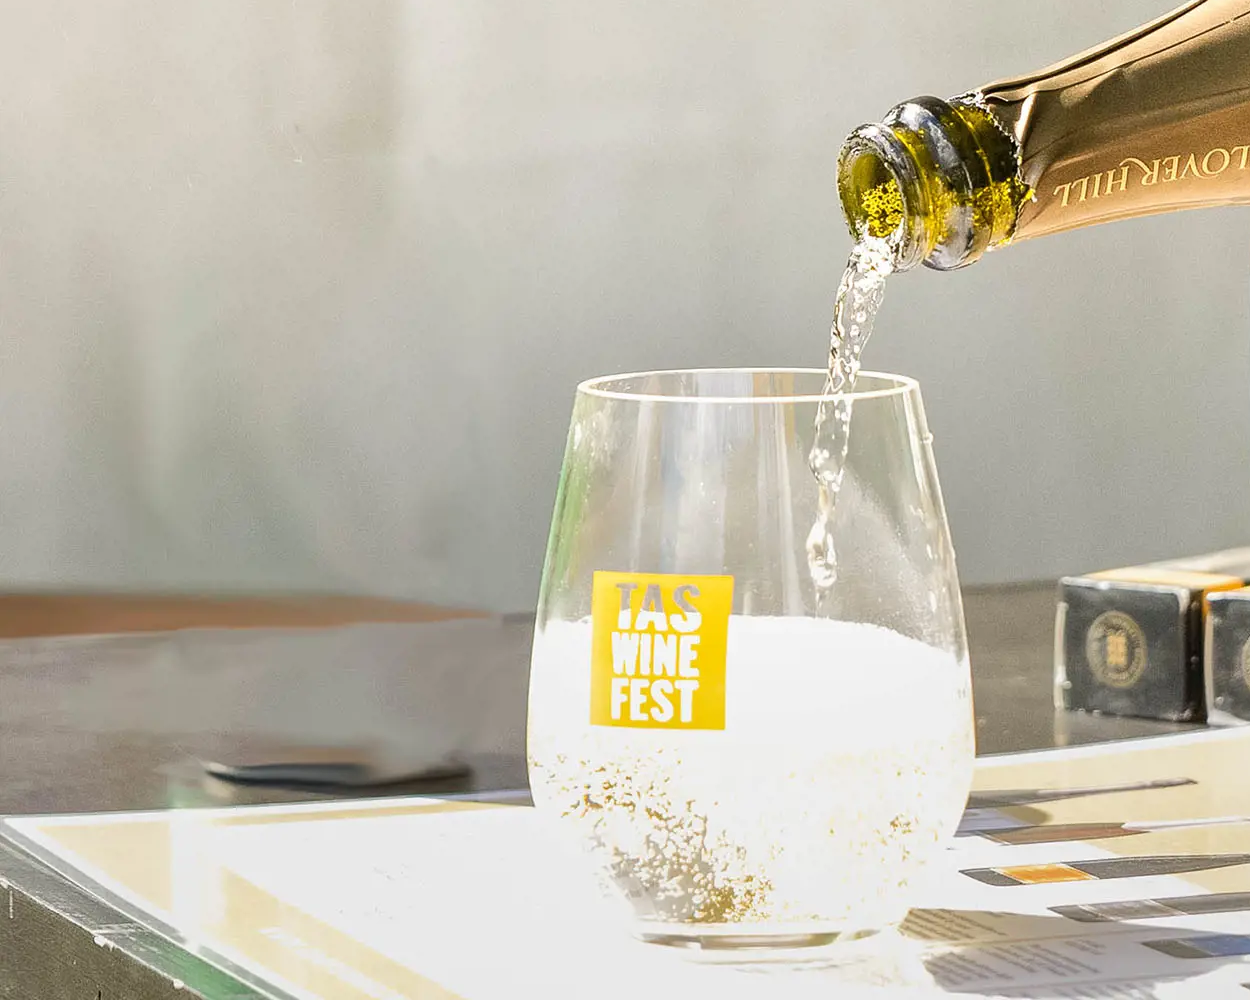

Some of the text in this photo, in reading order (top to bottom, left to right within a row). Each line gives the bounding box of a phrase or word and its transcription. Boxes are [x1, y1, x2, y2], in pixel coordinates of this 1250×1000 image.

[1053, 166, 1130, 208] HILL
[615, 582, 702, 633] TAS
[611, 631, 701, 677] WINE
[611, 677, 700, 722] FEST
